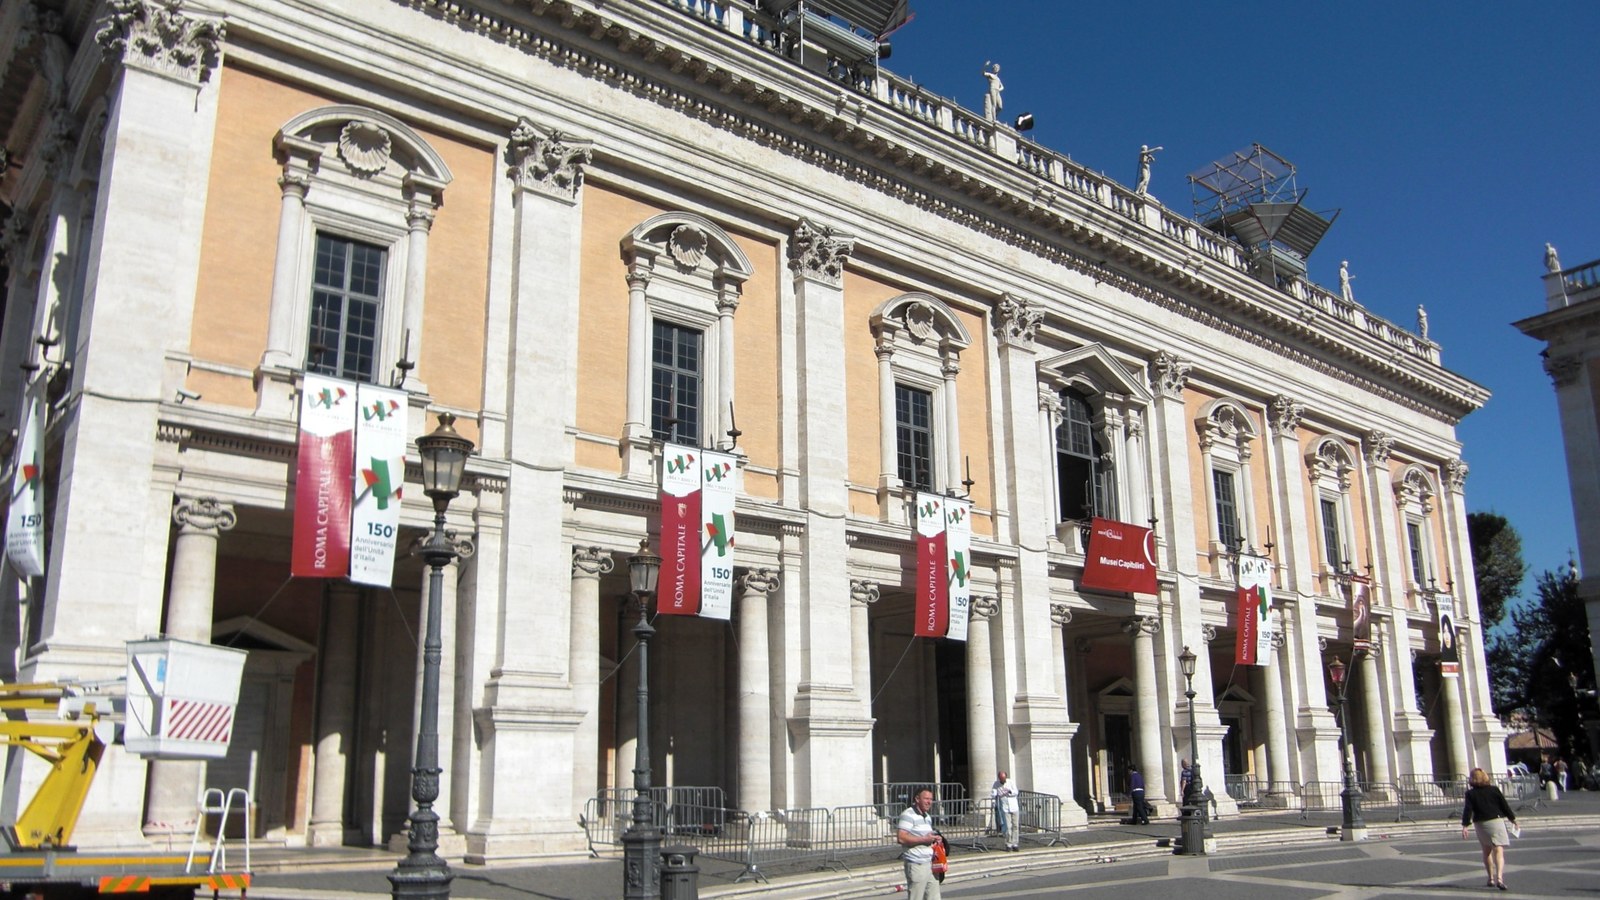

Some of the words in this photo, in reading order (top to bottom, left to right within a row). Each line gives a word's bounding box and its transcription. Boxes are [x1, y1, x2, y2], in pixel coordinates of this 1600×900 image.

[317, 468, 331, 525] CAPITALE
[314, 527, 328, 569] ROMA
[355, 536, 394, 549] Anniversario
[676, 524, 686, 572] CAPITALE
[1100, 556, 1118, 566] Musei
[1118, 559, 1145, 570] Capitolini
[674, 574, 685, 607] ROMA
[928, 602, 936, 631] ROMA
